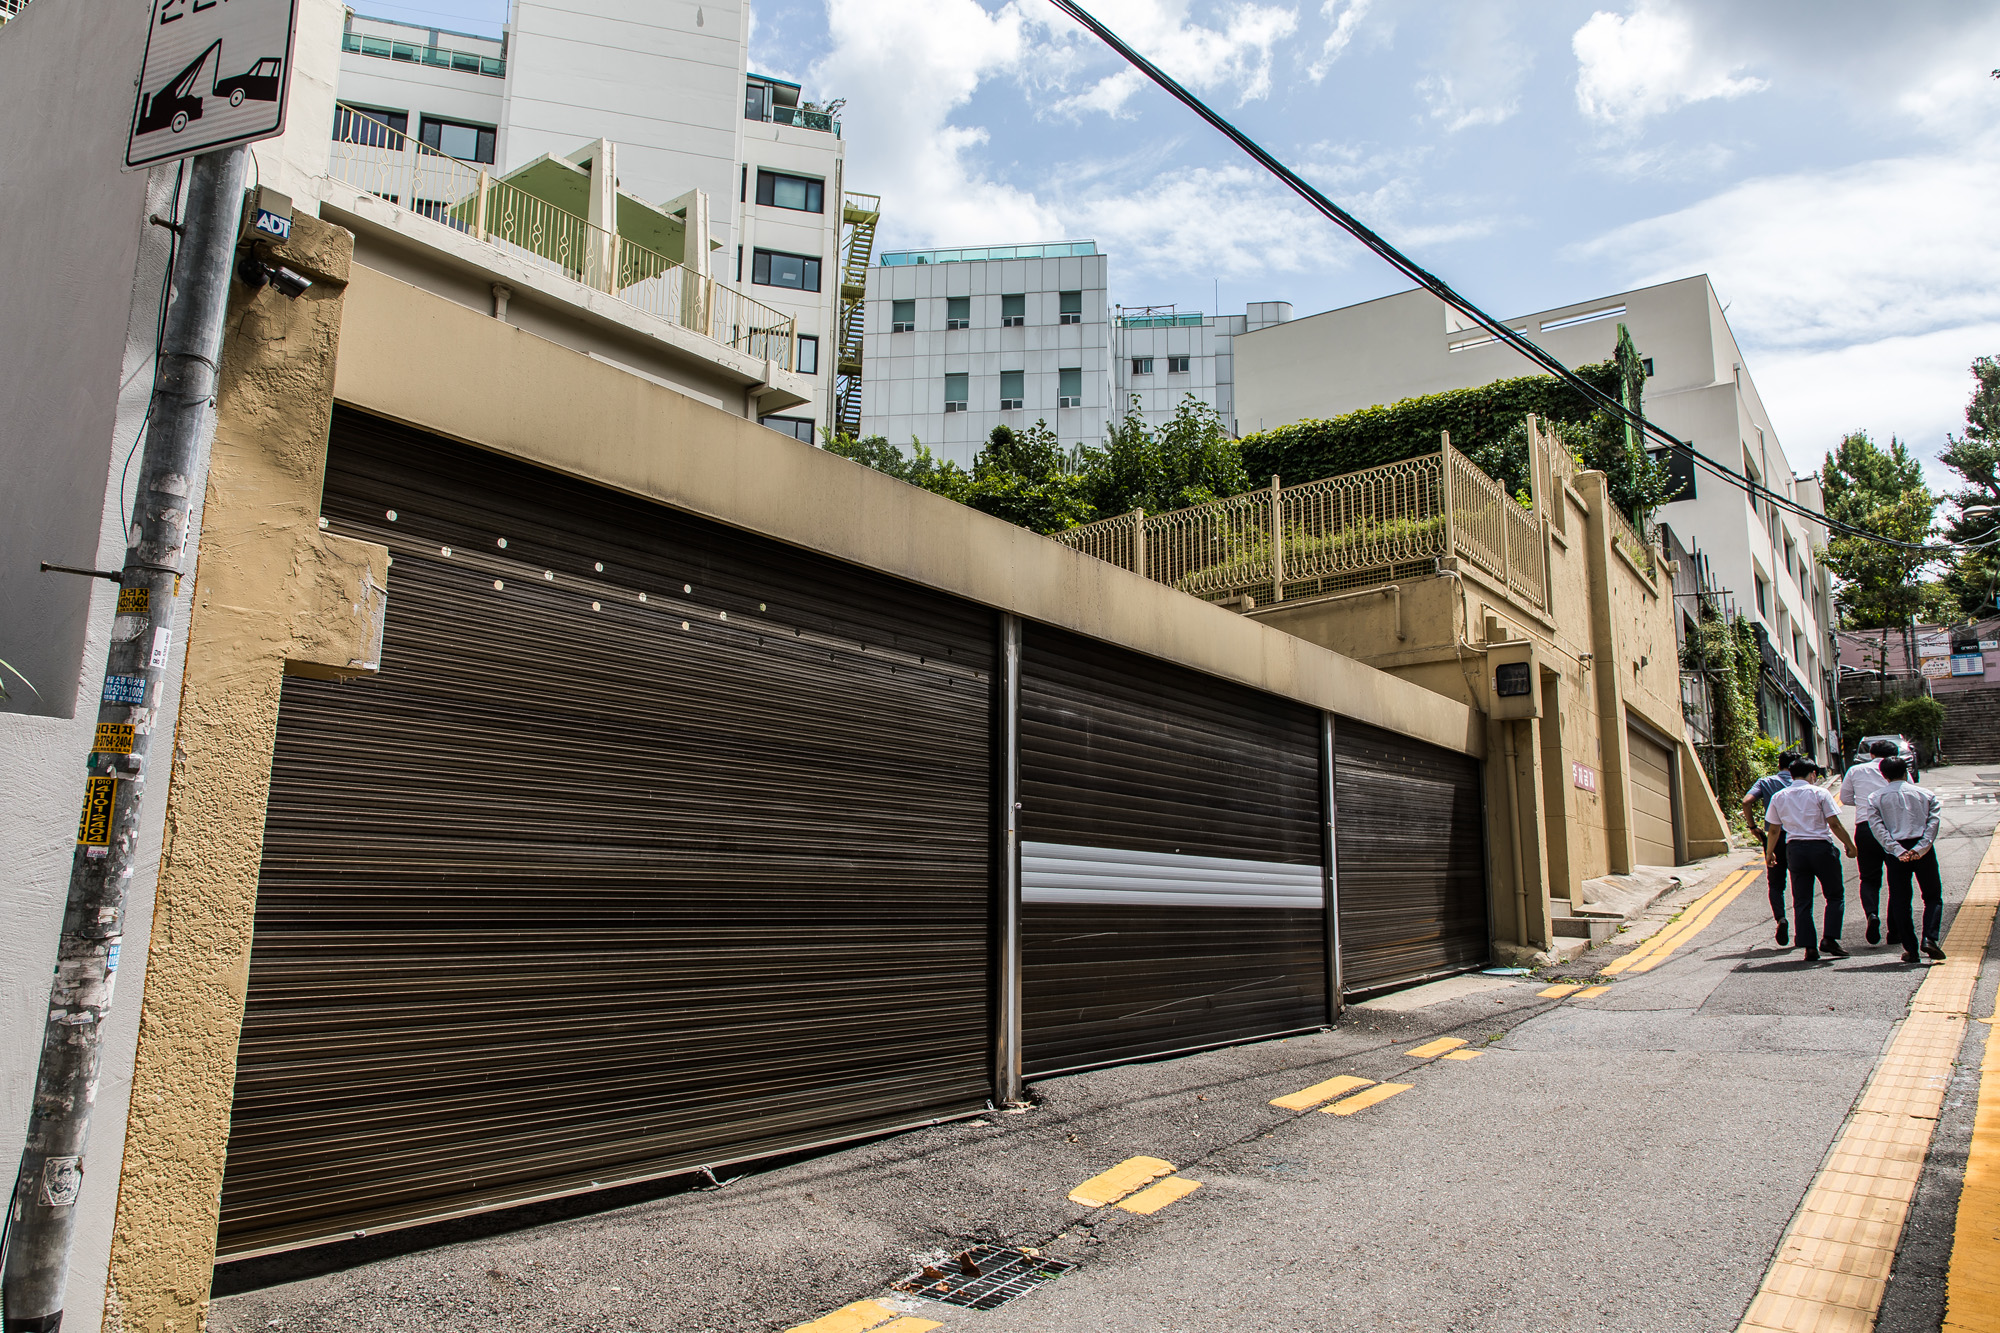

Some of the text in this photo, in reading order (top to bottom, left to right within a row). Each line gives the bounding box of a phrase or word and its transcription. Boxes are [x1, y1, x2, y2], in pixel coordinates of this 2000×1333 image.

[256, 213, 291, 238] ADT
[115, 677, 125, 685] 소형
[127, 678, 145, 688] 이삿짐
[1572, 764, 1595, 790] 주차금지
